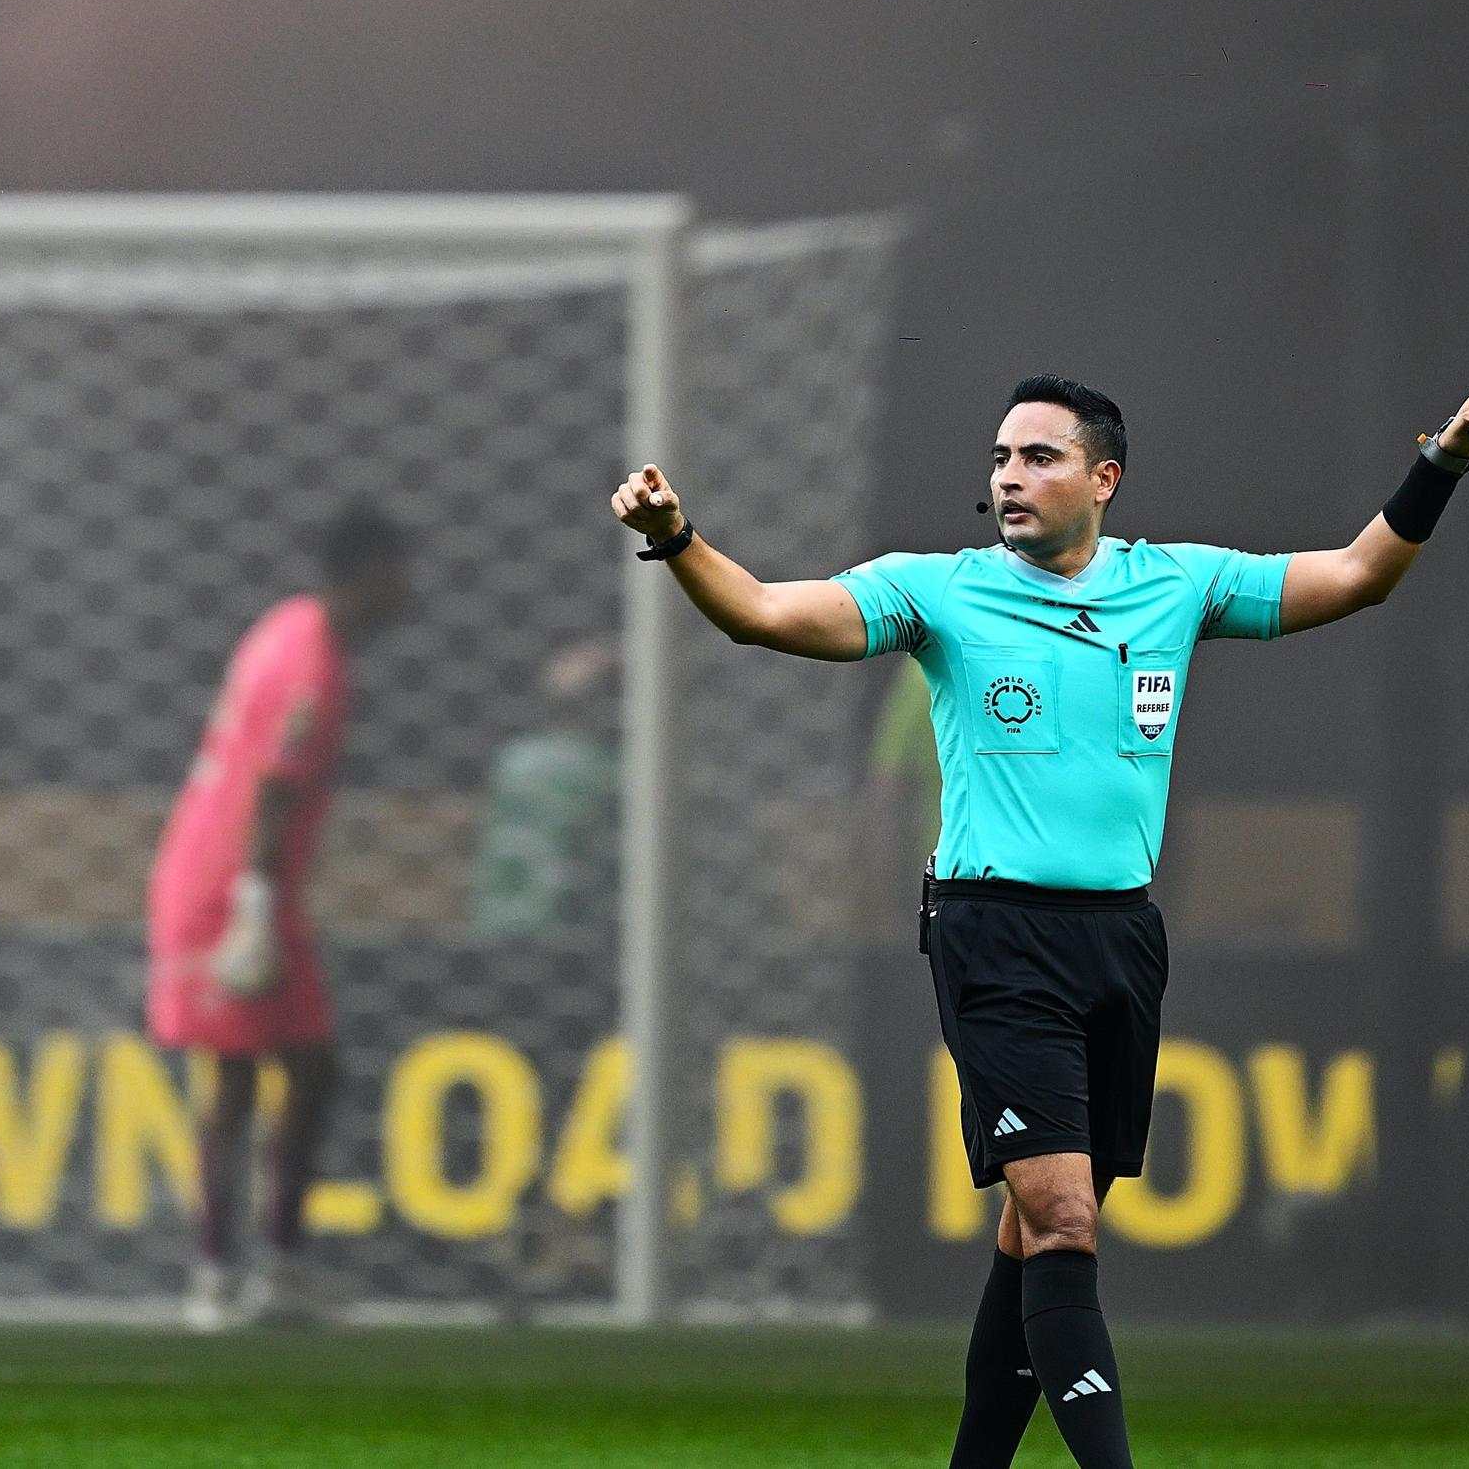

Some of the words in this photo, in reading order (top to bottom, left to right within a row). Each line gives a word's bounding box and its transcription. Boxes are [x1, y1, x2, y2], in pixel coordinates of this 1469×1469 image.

[1137, 676, 1171, 692] FIFA
[983, 691, 991, 716] CLUB
[990, 676, 1023, 689] WORLD
[1026, 683, 1041, 700] CUP
[1035, 704, 1042, 716] 25
[1136, 703, 1170, 713] REFEREE
[1144, 726, 1160, 735] 2025
